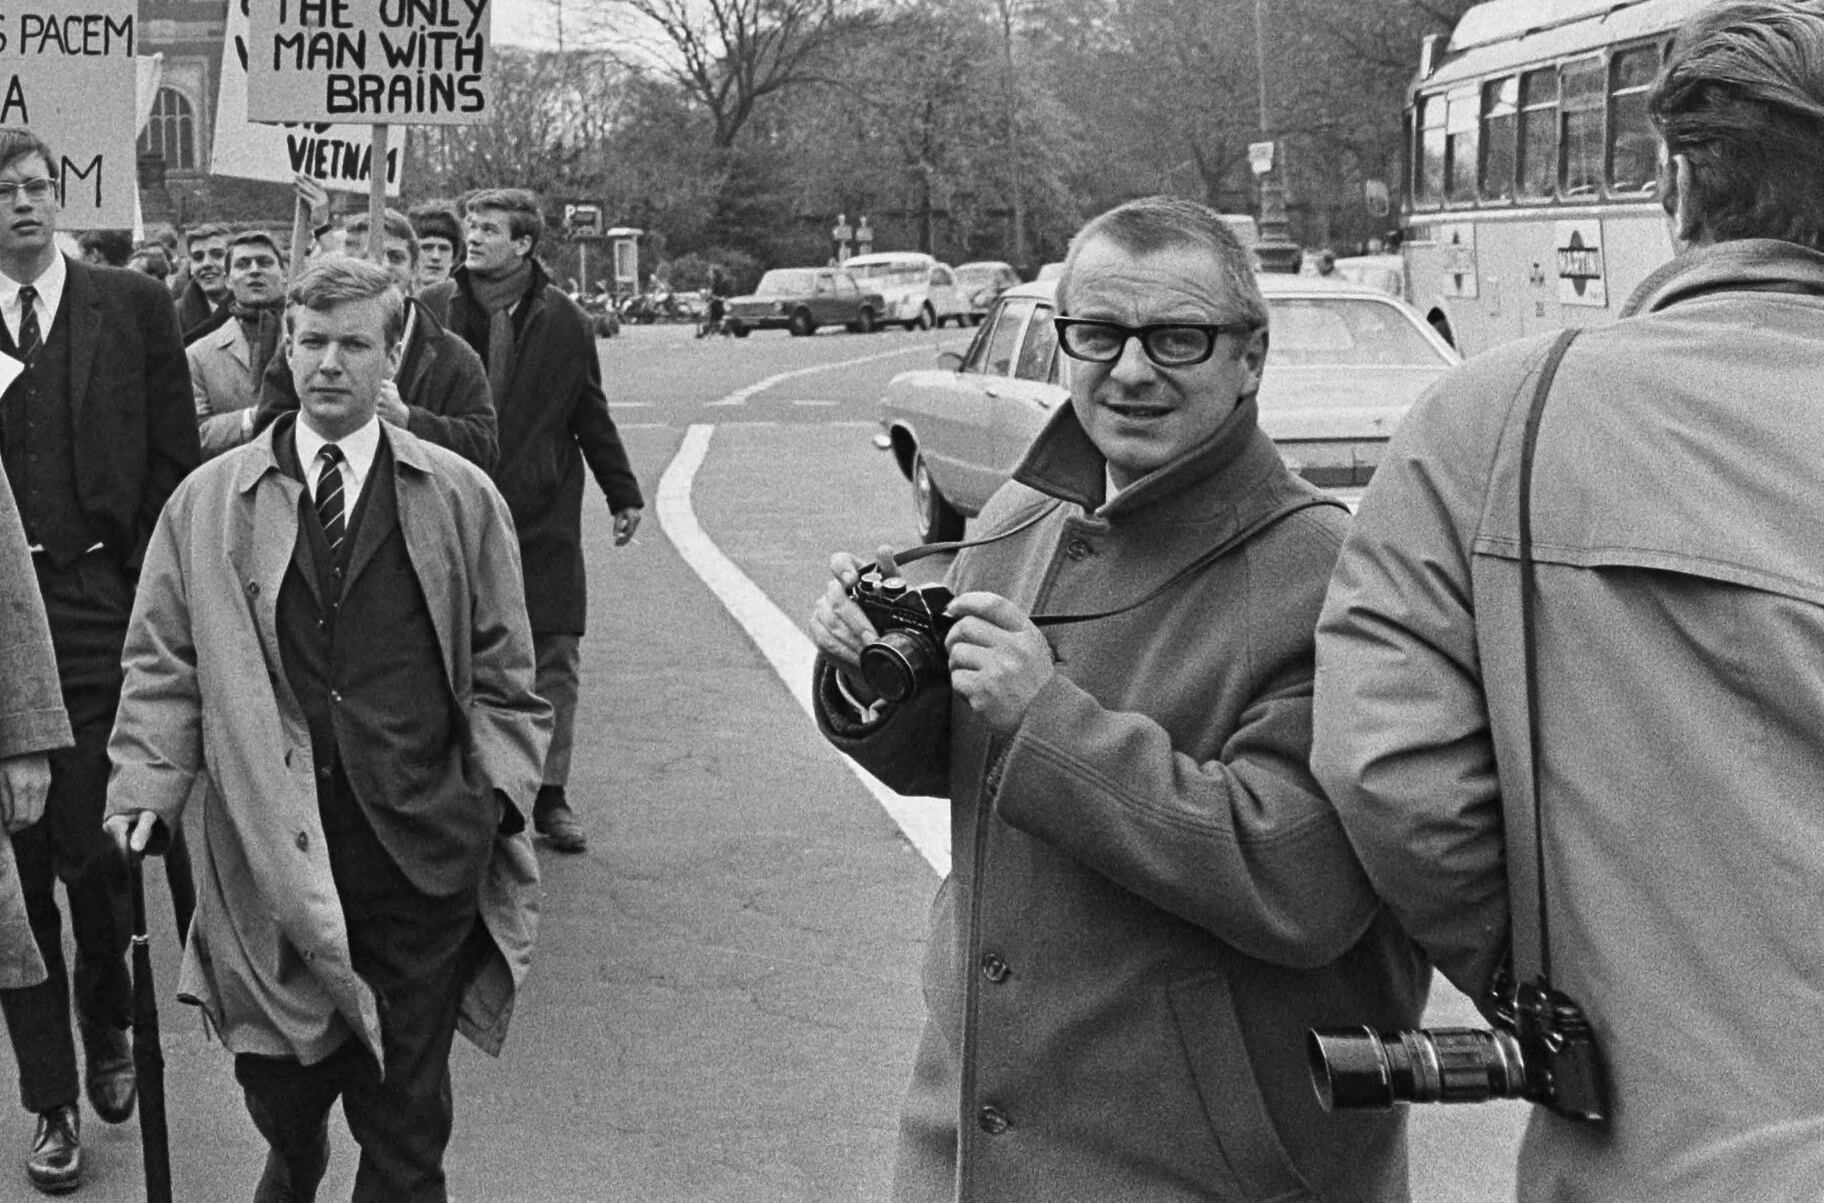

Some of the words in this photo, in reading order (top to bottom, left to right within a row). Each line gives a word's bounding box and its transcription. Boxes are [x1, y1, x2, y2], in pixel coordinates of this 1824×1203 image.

[21, 14, 133, 57] PACEM
[273, 29, 366, 71] MAN
[379, 25, 483, 73] WITH
[326, 69, 485, 114] BRAINS
